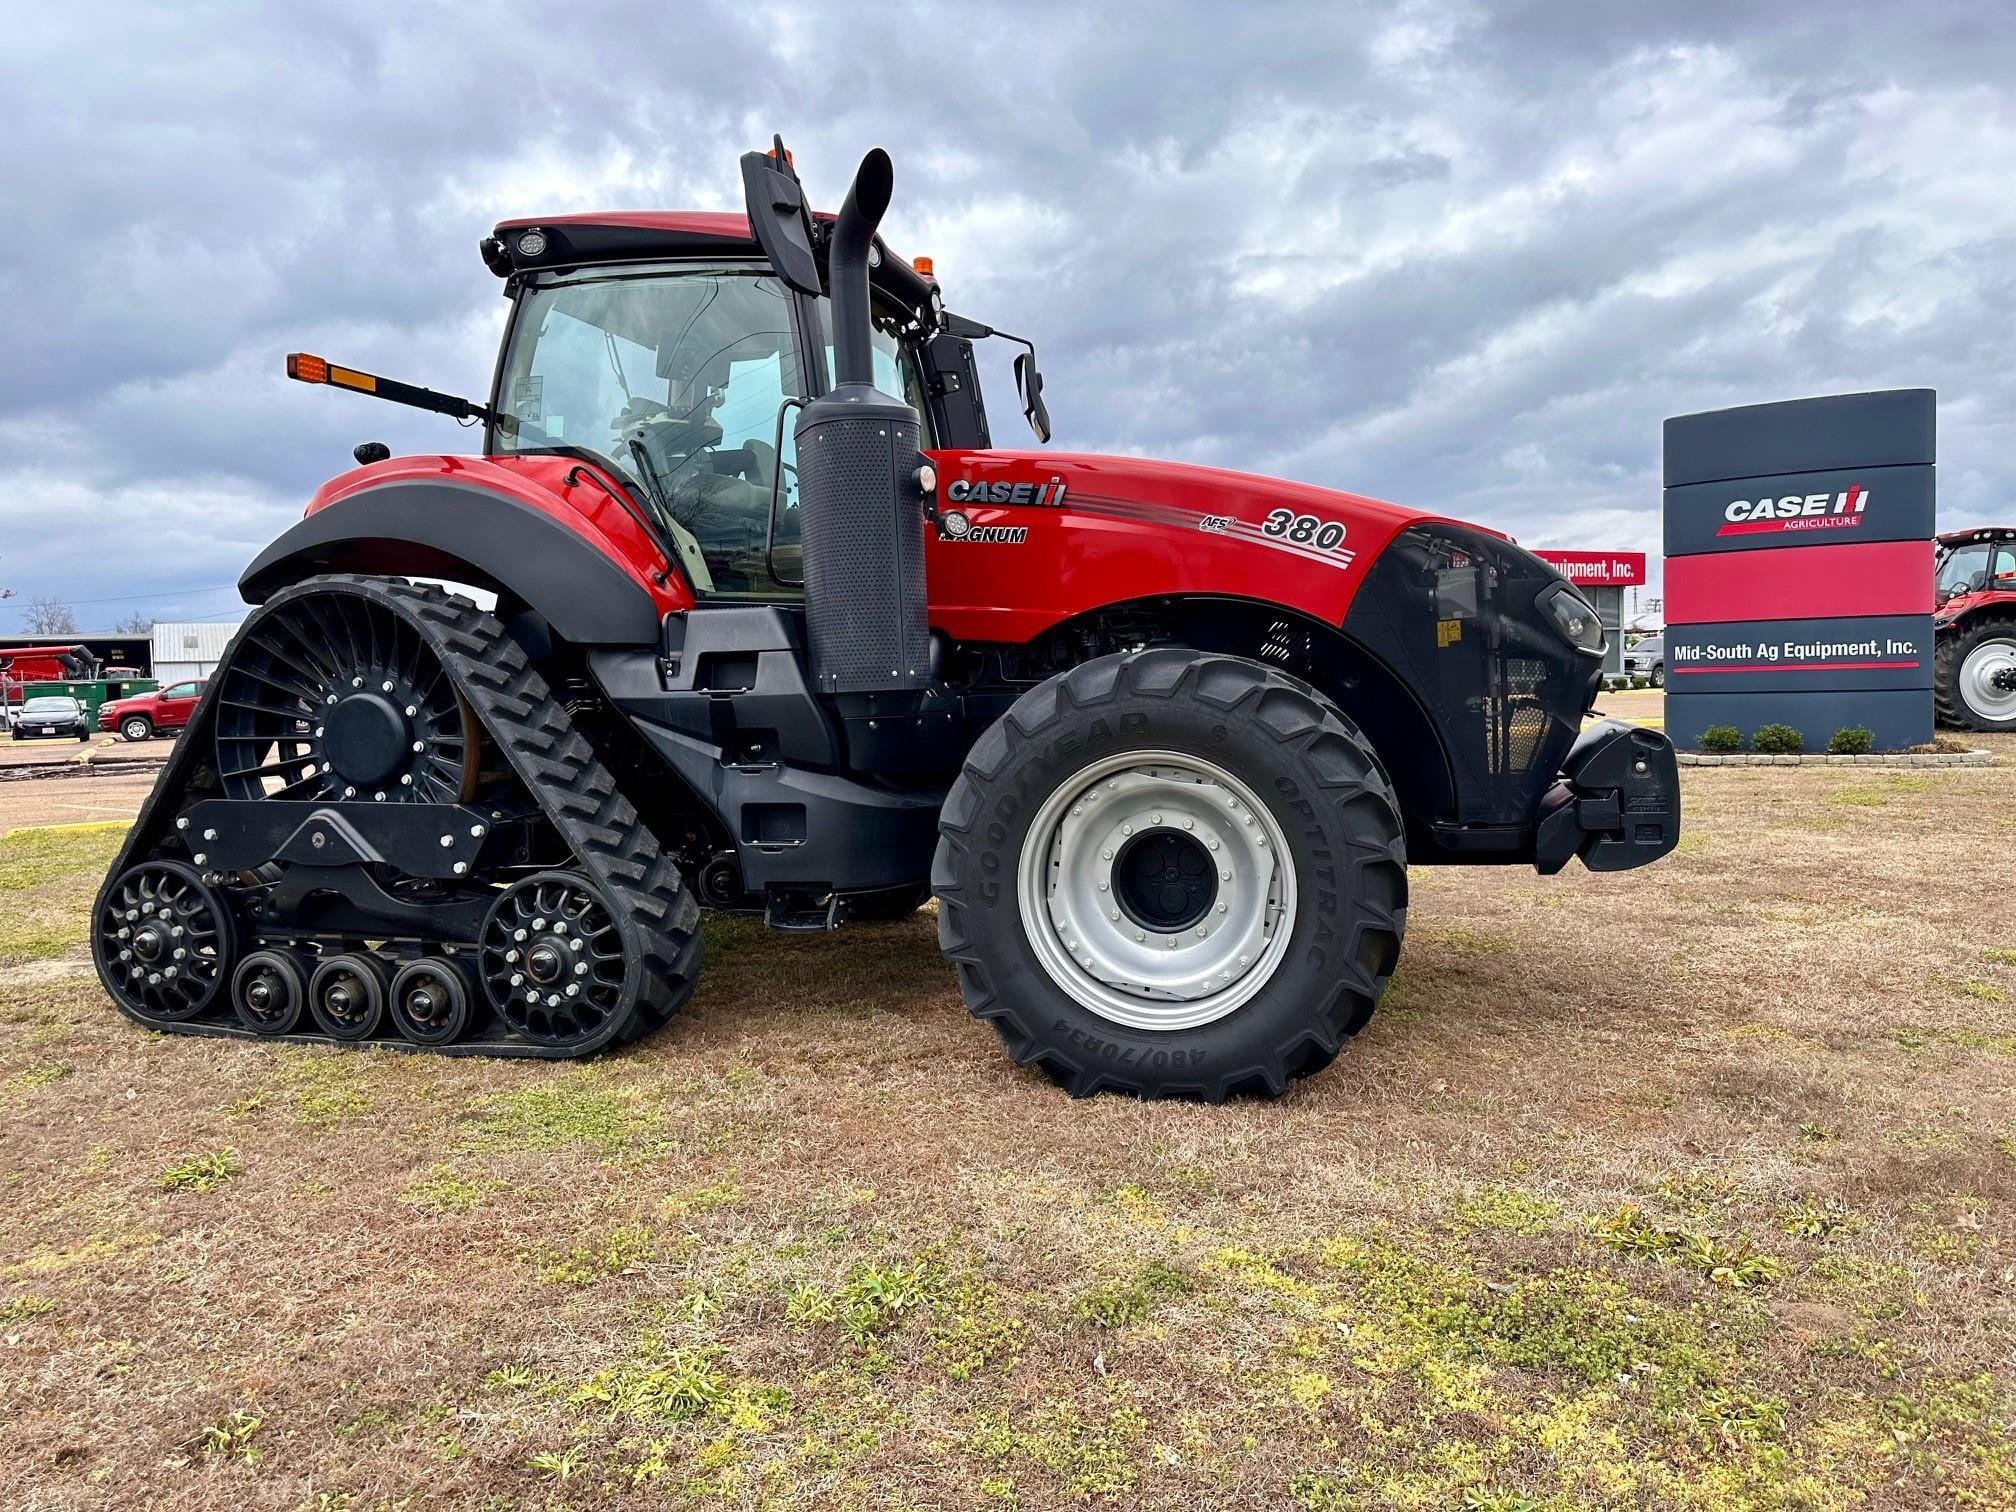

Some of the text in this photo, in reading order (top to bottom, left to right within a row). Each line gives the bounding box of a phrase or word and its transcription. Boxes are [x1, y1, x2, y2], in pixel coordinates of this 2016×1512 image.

[947, 480, 1034, 504] CASE
[1724, 493, 1830, 522] CASE
[1200, 515, 1229, 529] AFS
[1262, 508, 1346, 552] 380
[1784, 517, 1857, 529] AGRICULTURE
[939, 526, 1028, 543] GNUM
[1542, 558, 1634, 581] uipment, Inc.
[1674, 639, 1917, 661] Mid-South Ag Equipment, Inc.
[979, 712, 1148, 908] GOODYEAR
[1274, 776, 1337, 970] OPTITRAC
[1052, 1019, 1206, 1068] 480/70R34
